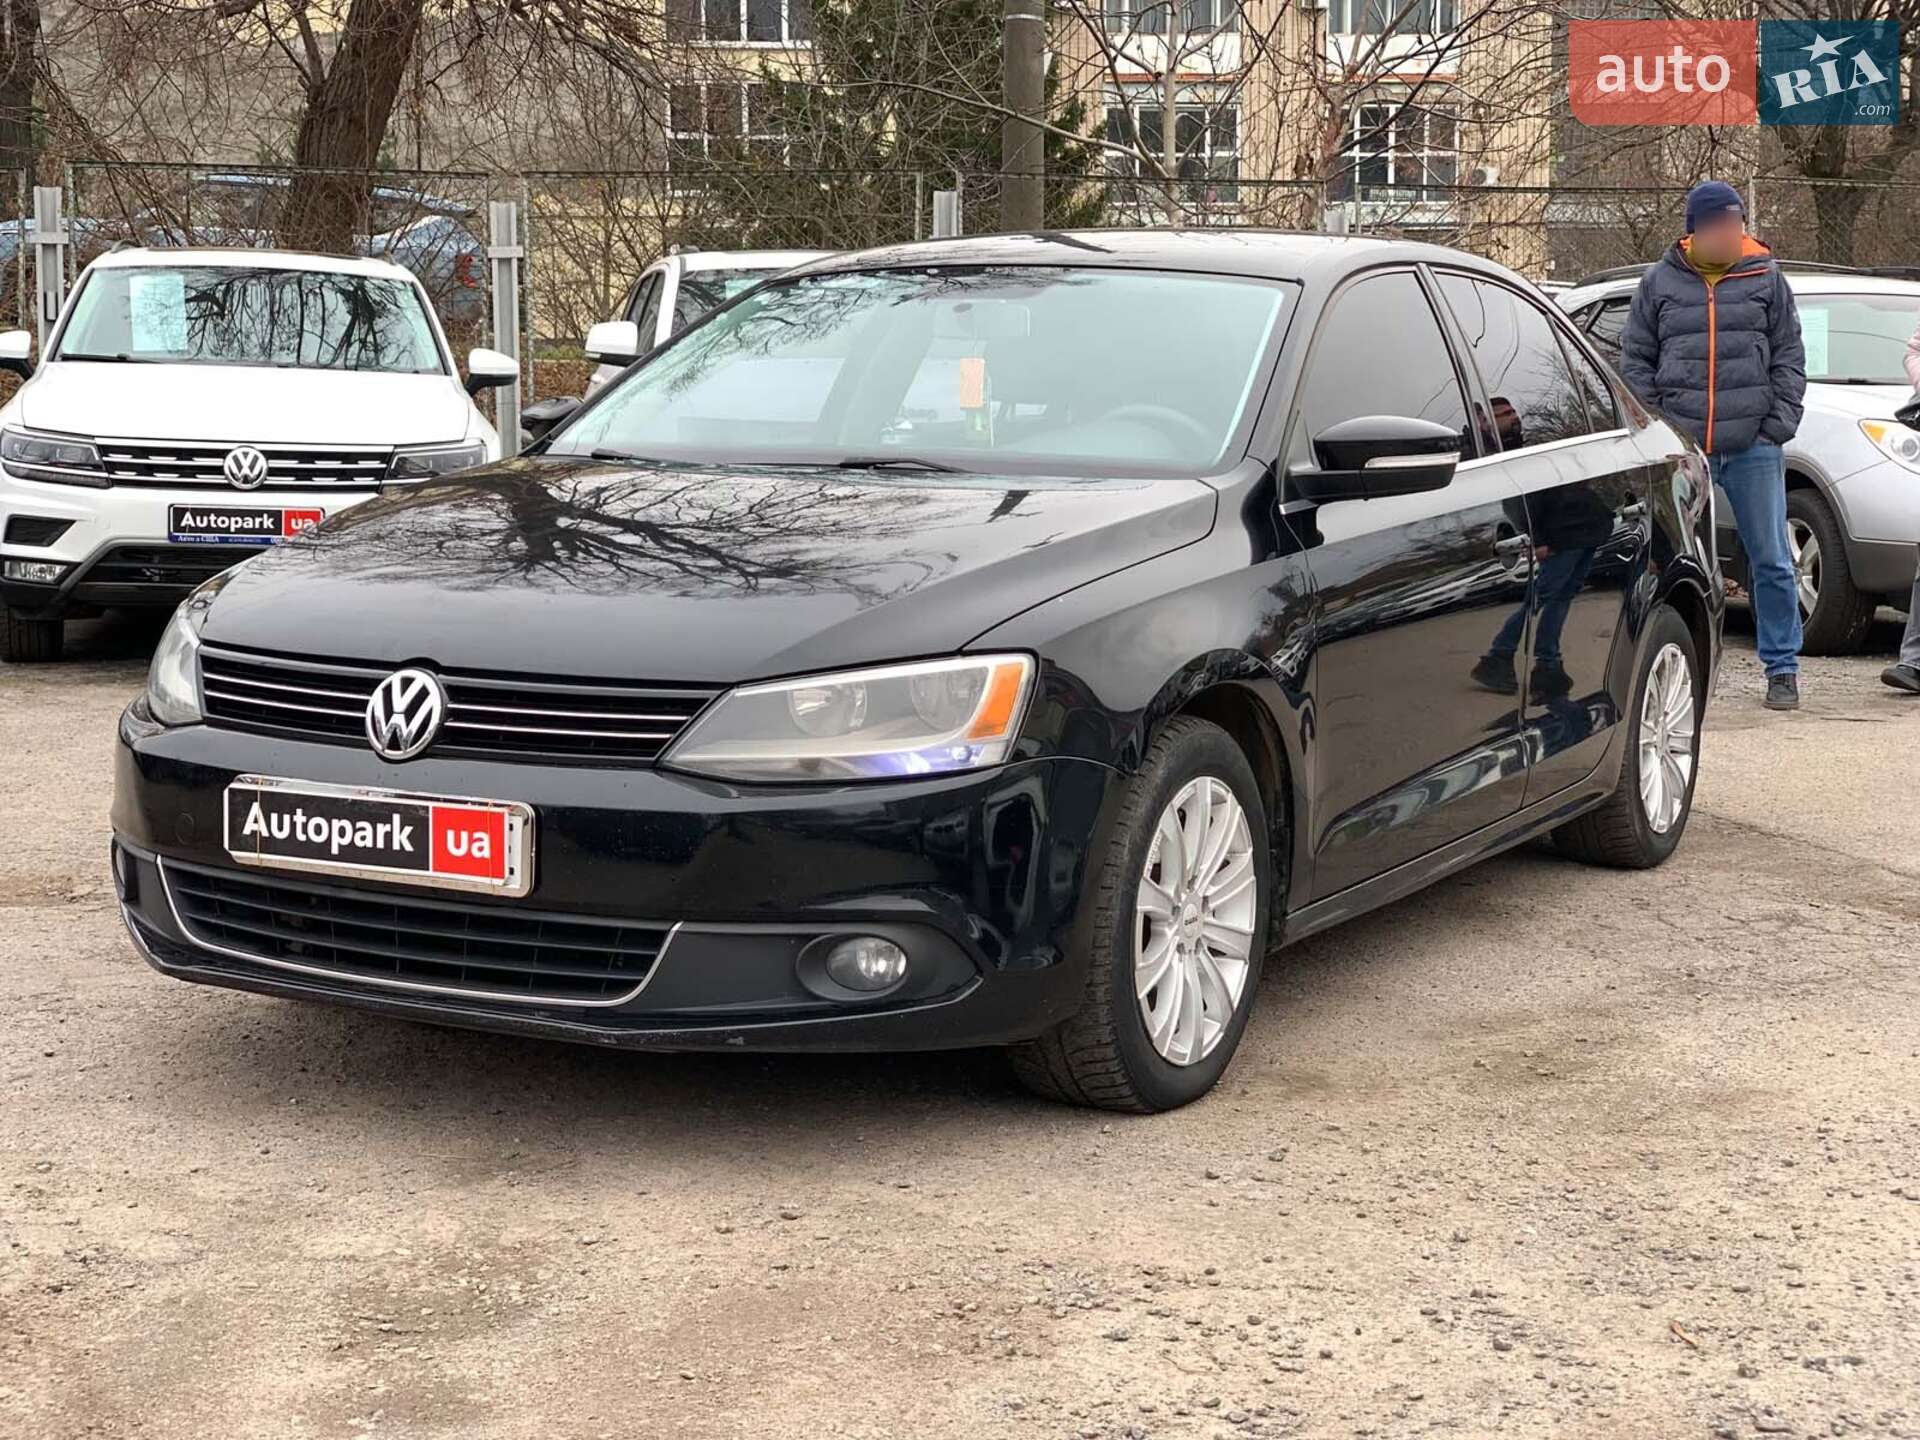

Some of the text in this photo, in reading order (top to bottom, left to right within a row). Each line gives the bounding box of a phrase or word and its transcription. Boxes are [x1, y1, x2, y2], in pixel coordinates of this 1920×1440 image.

[180, 511, 275, 532] Autopark
[242, 801, 491, 859] Autopark ua
